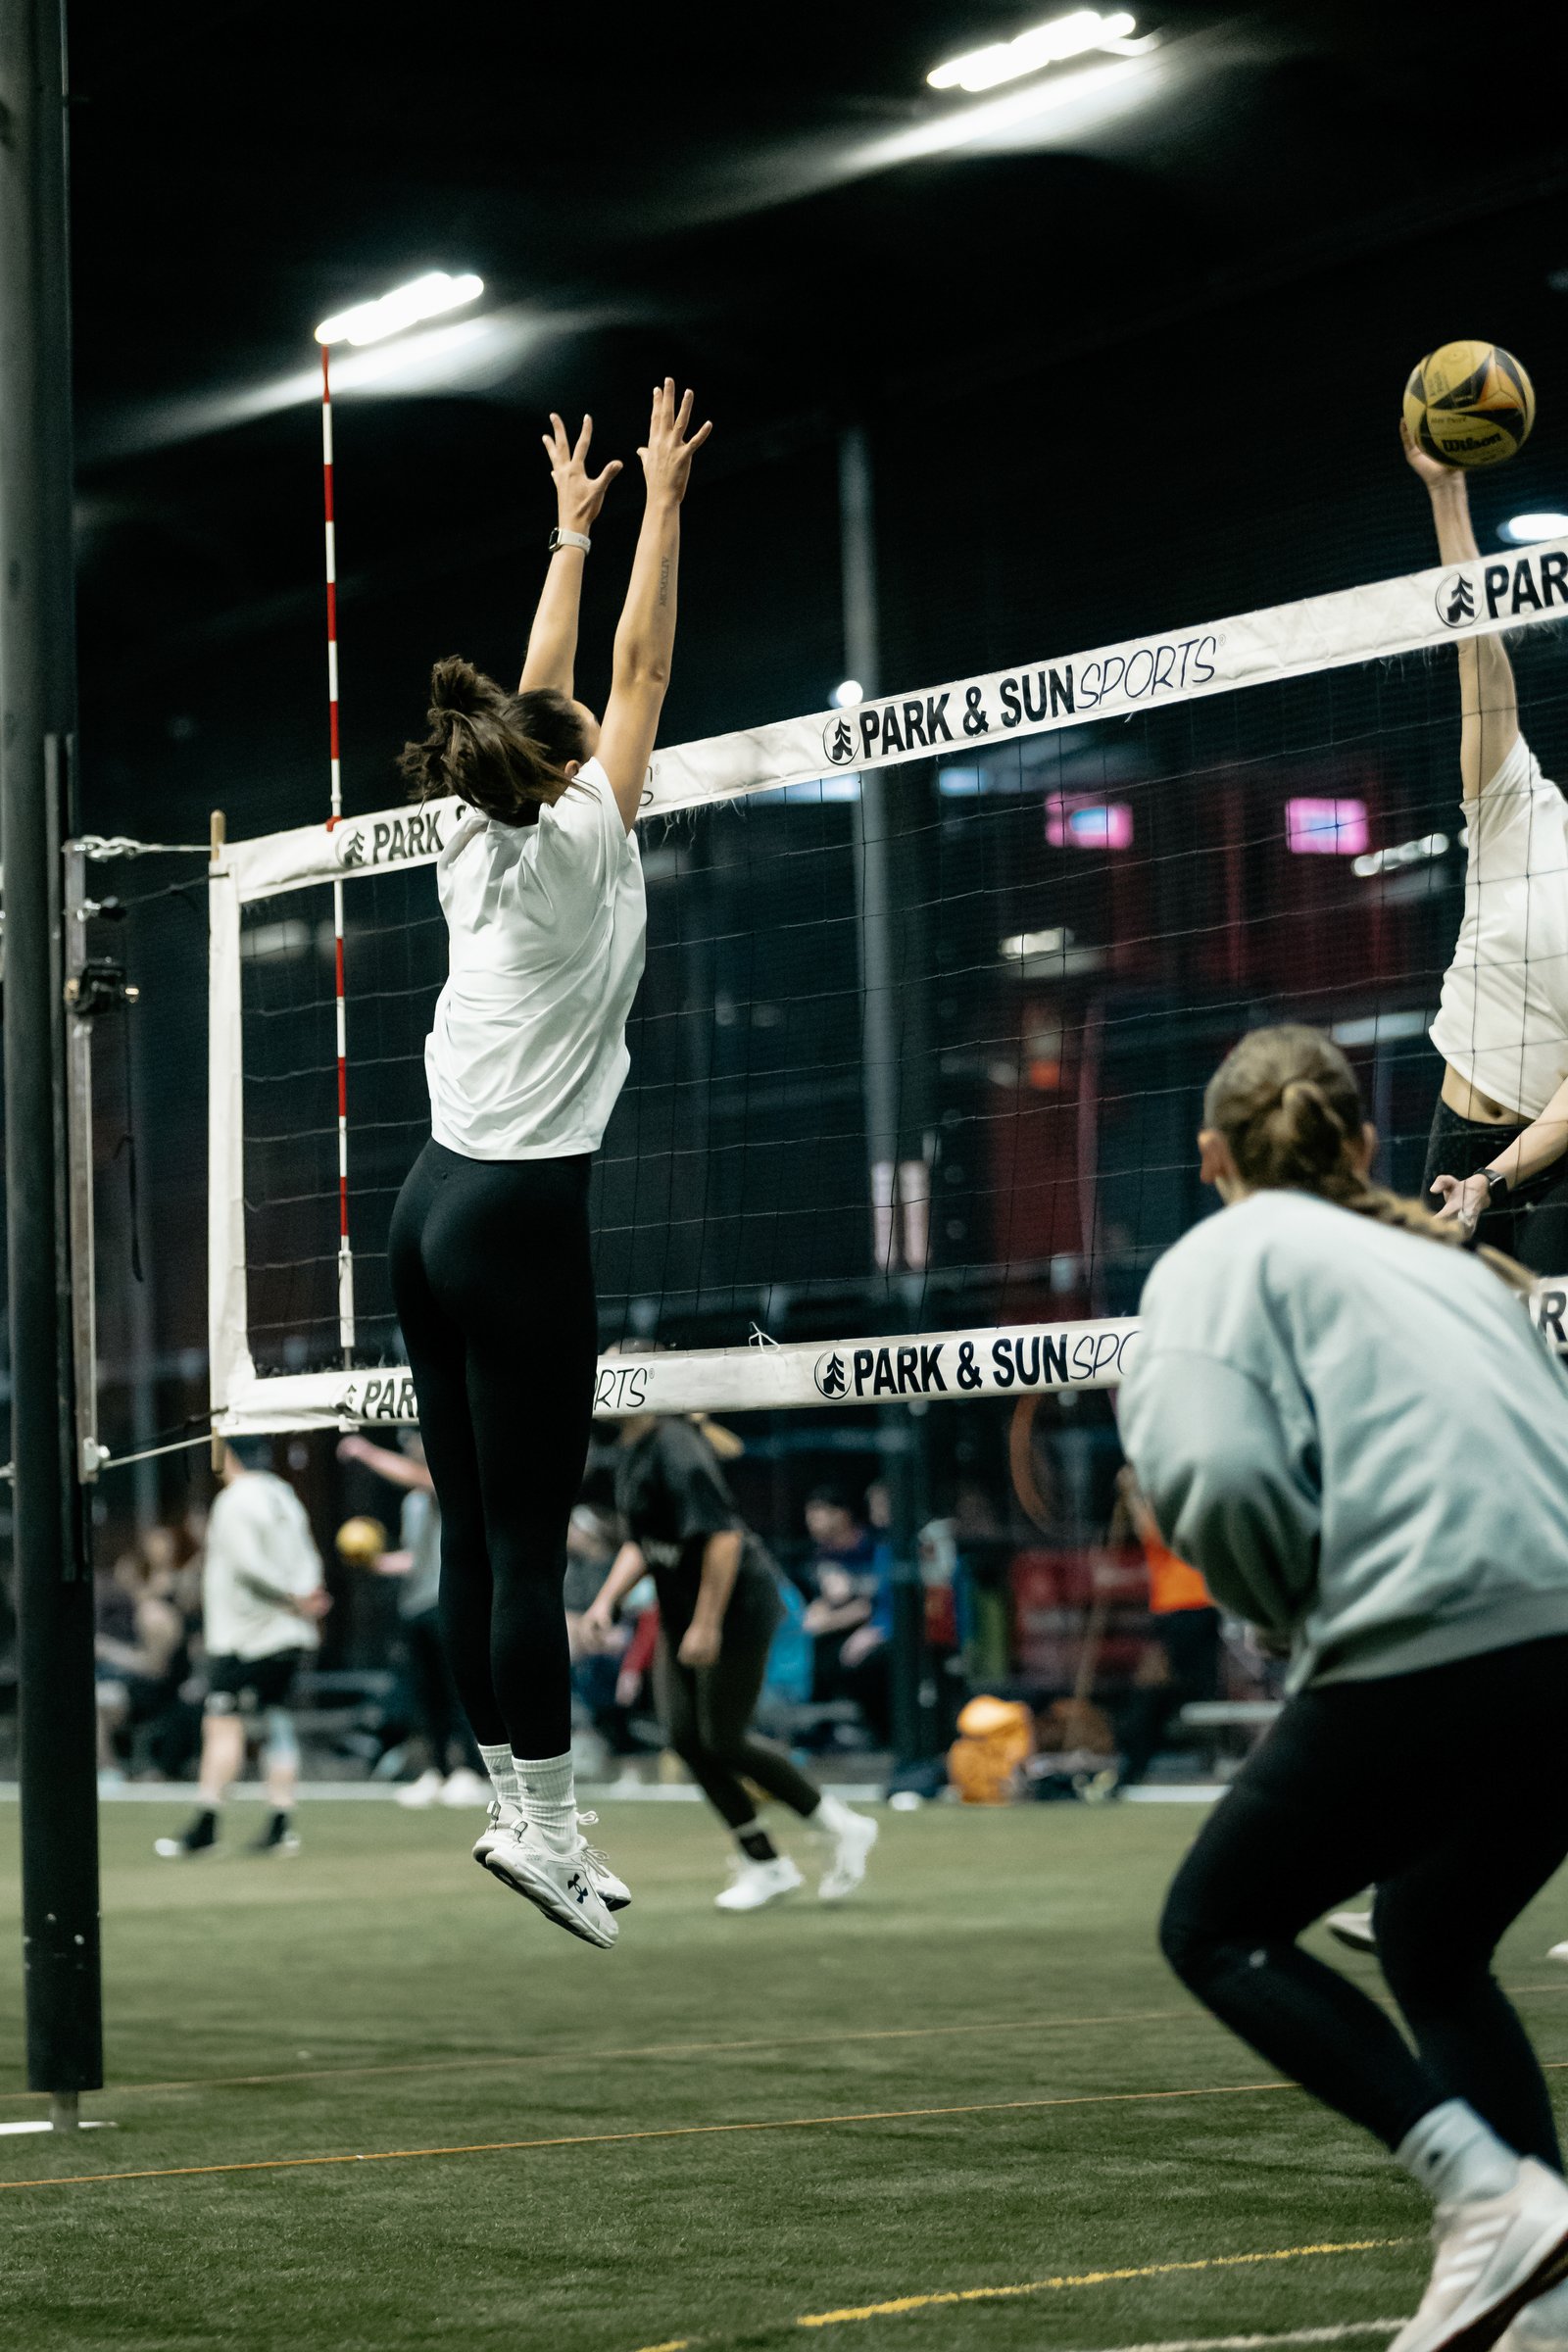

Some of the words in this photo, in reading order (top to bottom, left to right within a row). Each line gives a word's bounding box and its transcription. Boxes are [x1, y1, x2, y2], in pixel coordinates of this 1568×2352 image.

[1442, 433, 1501, 452] Wilson
[1485, 551, 1568, 619] PAR
[860, 692, 953, 760] PARK
[963, 685, 989, 737] &
[373, 810, 444, 864] PARK
[594, 1367, 647, 1410] RTS
[854, 1343, 948, 1396] PARK
[956, 1341, 983, 1391] &
[362, 1377, 416, 1419] PAR
